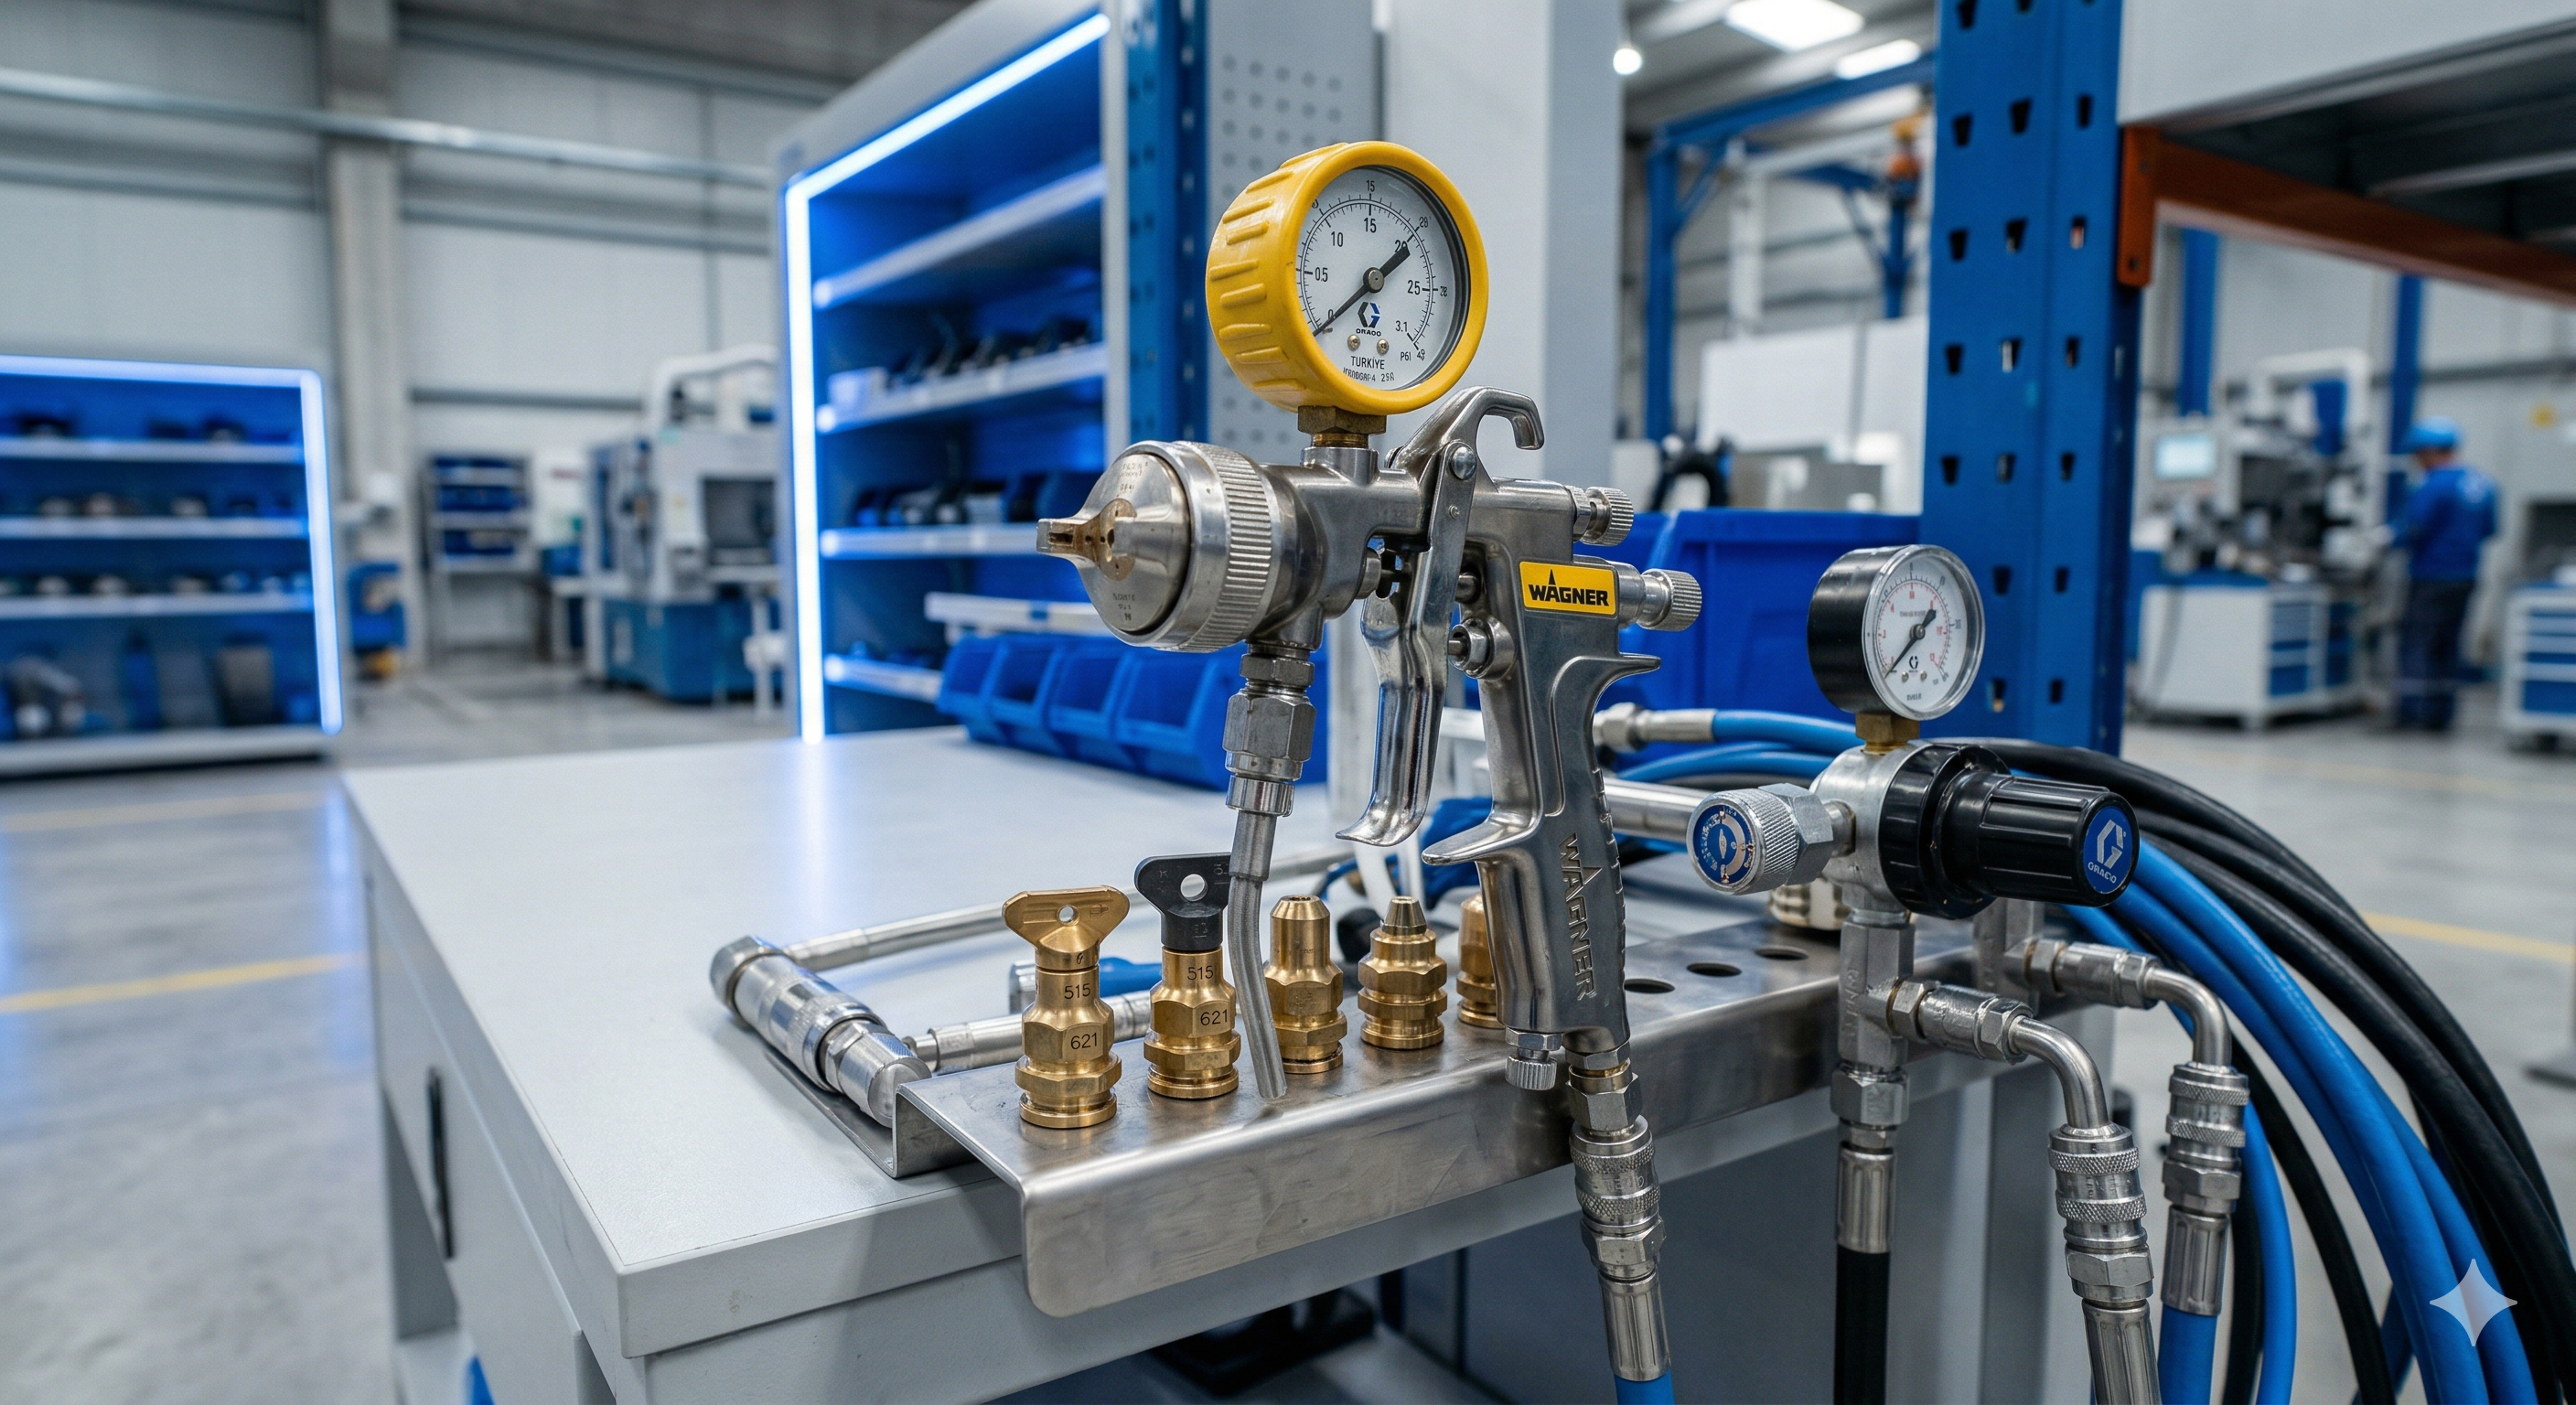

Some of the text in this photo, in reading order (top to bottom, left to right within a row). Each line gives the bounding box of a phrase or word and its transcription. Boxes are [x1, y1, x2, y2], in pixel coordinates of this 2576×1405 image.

[1366, 179, 1376, 192] 15
[1363, 217, 1377, 233] 15
[1330, 231, 1344, 248] 10
[1407, 279, 1421, 295] 25
[1395, 320, 1408, 332] 3.1
[1528, 568, 1610, 606] WAGNER
[1559, 831, 1603, 1002] WAGNER
[1186, 965, 1214, 981] 515
[1064, 982, 1091, 1000] 515
[1200, 1009, 1228, 1026] 621
[1070, 1032, 1098, 1050] 621
